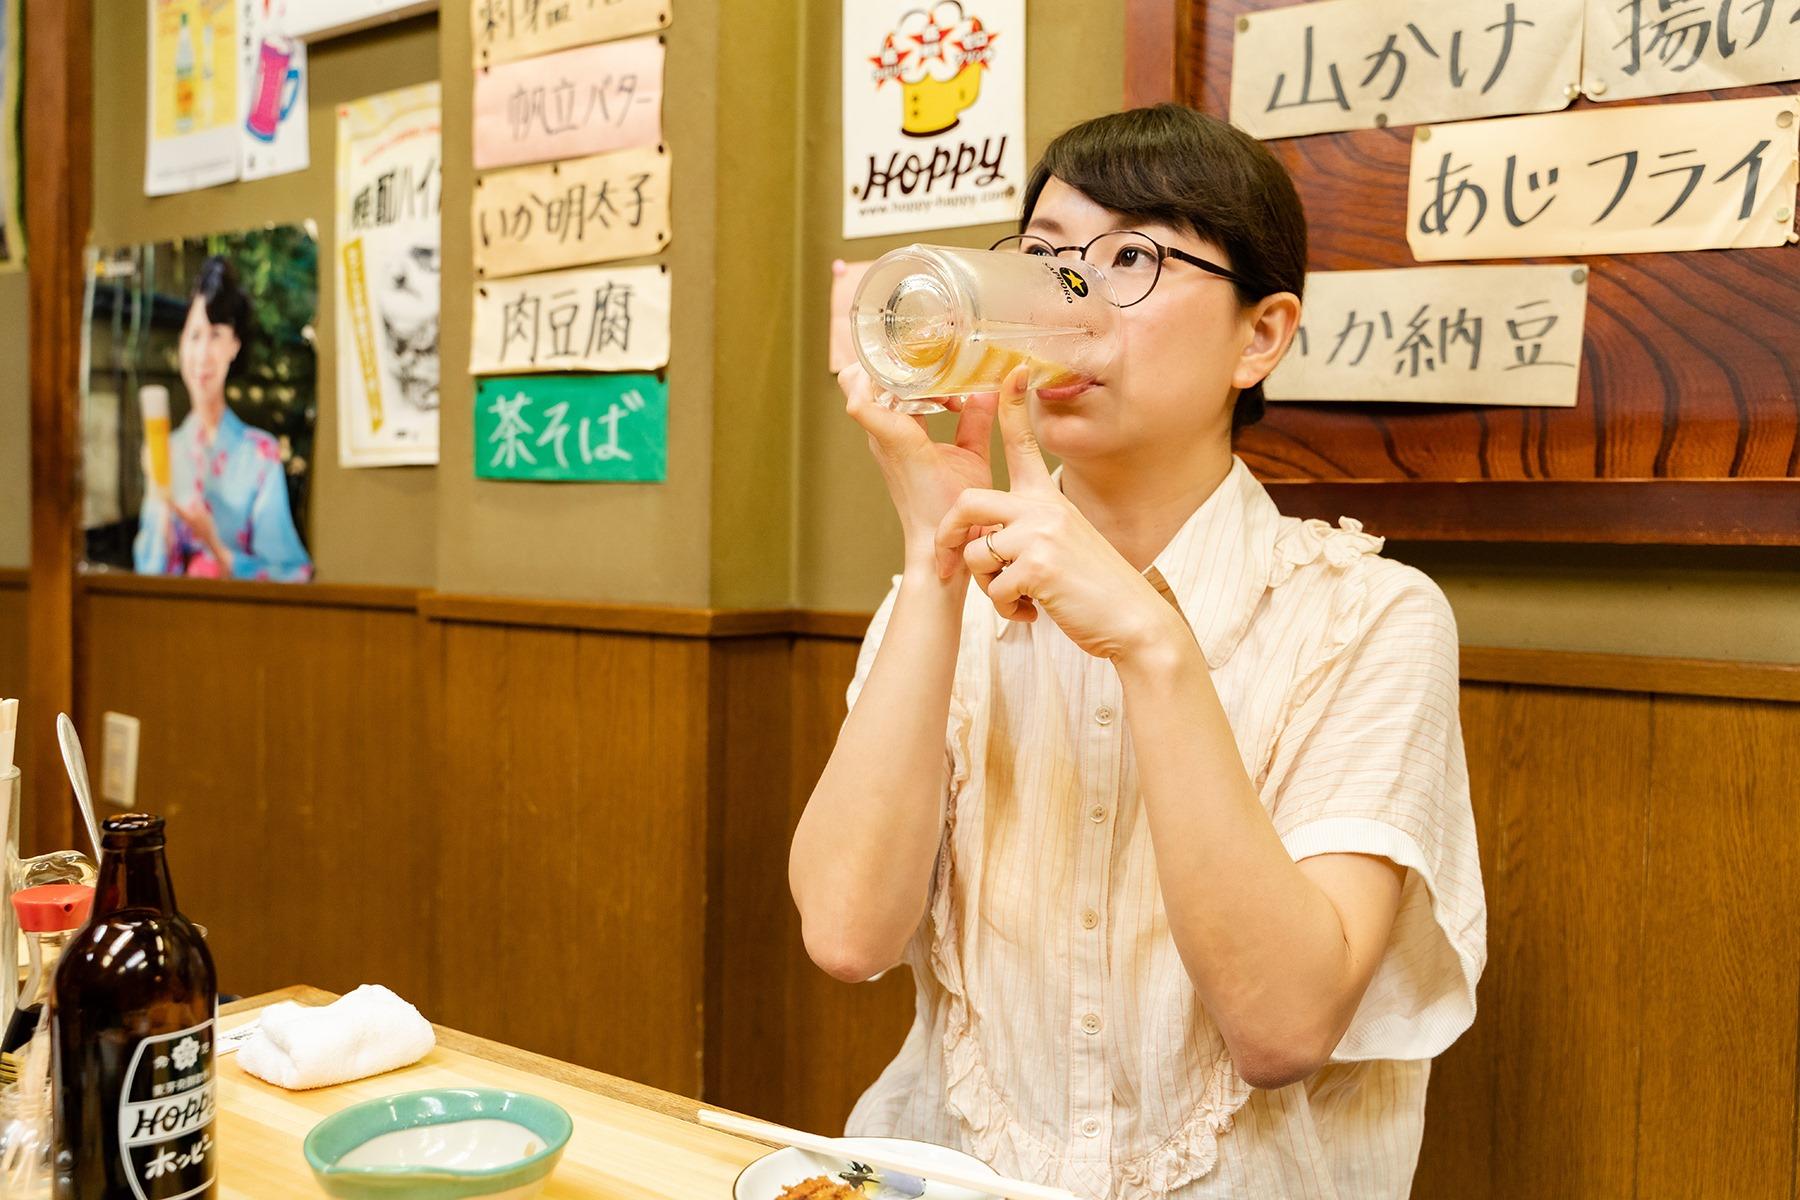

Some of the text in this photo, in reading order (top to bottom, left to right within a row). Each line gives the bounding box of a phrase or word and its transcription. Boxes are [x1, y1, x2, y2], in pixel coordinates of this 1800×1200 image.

[1264, 2, 1536, 113] 山かけ
[480, 172, 652, 248] いか明太子
[1418, 139, 1772, 237] あじフライ
[501, 281, 635, 364] 肉豆腐
[487, 388, 646, 470] 茶そば
